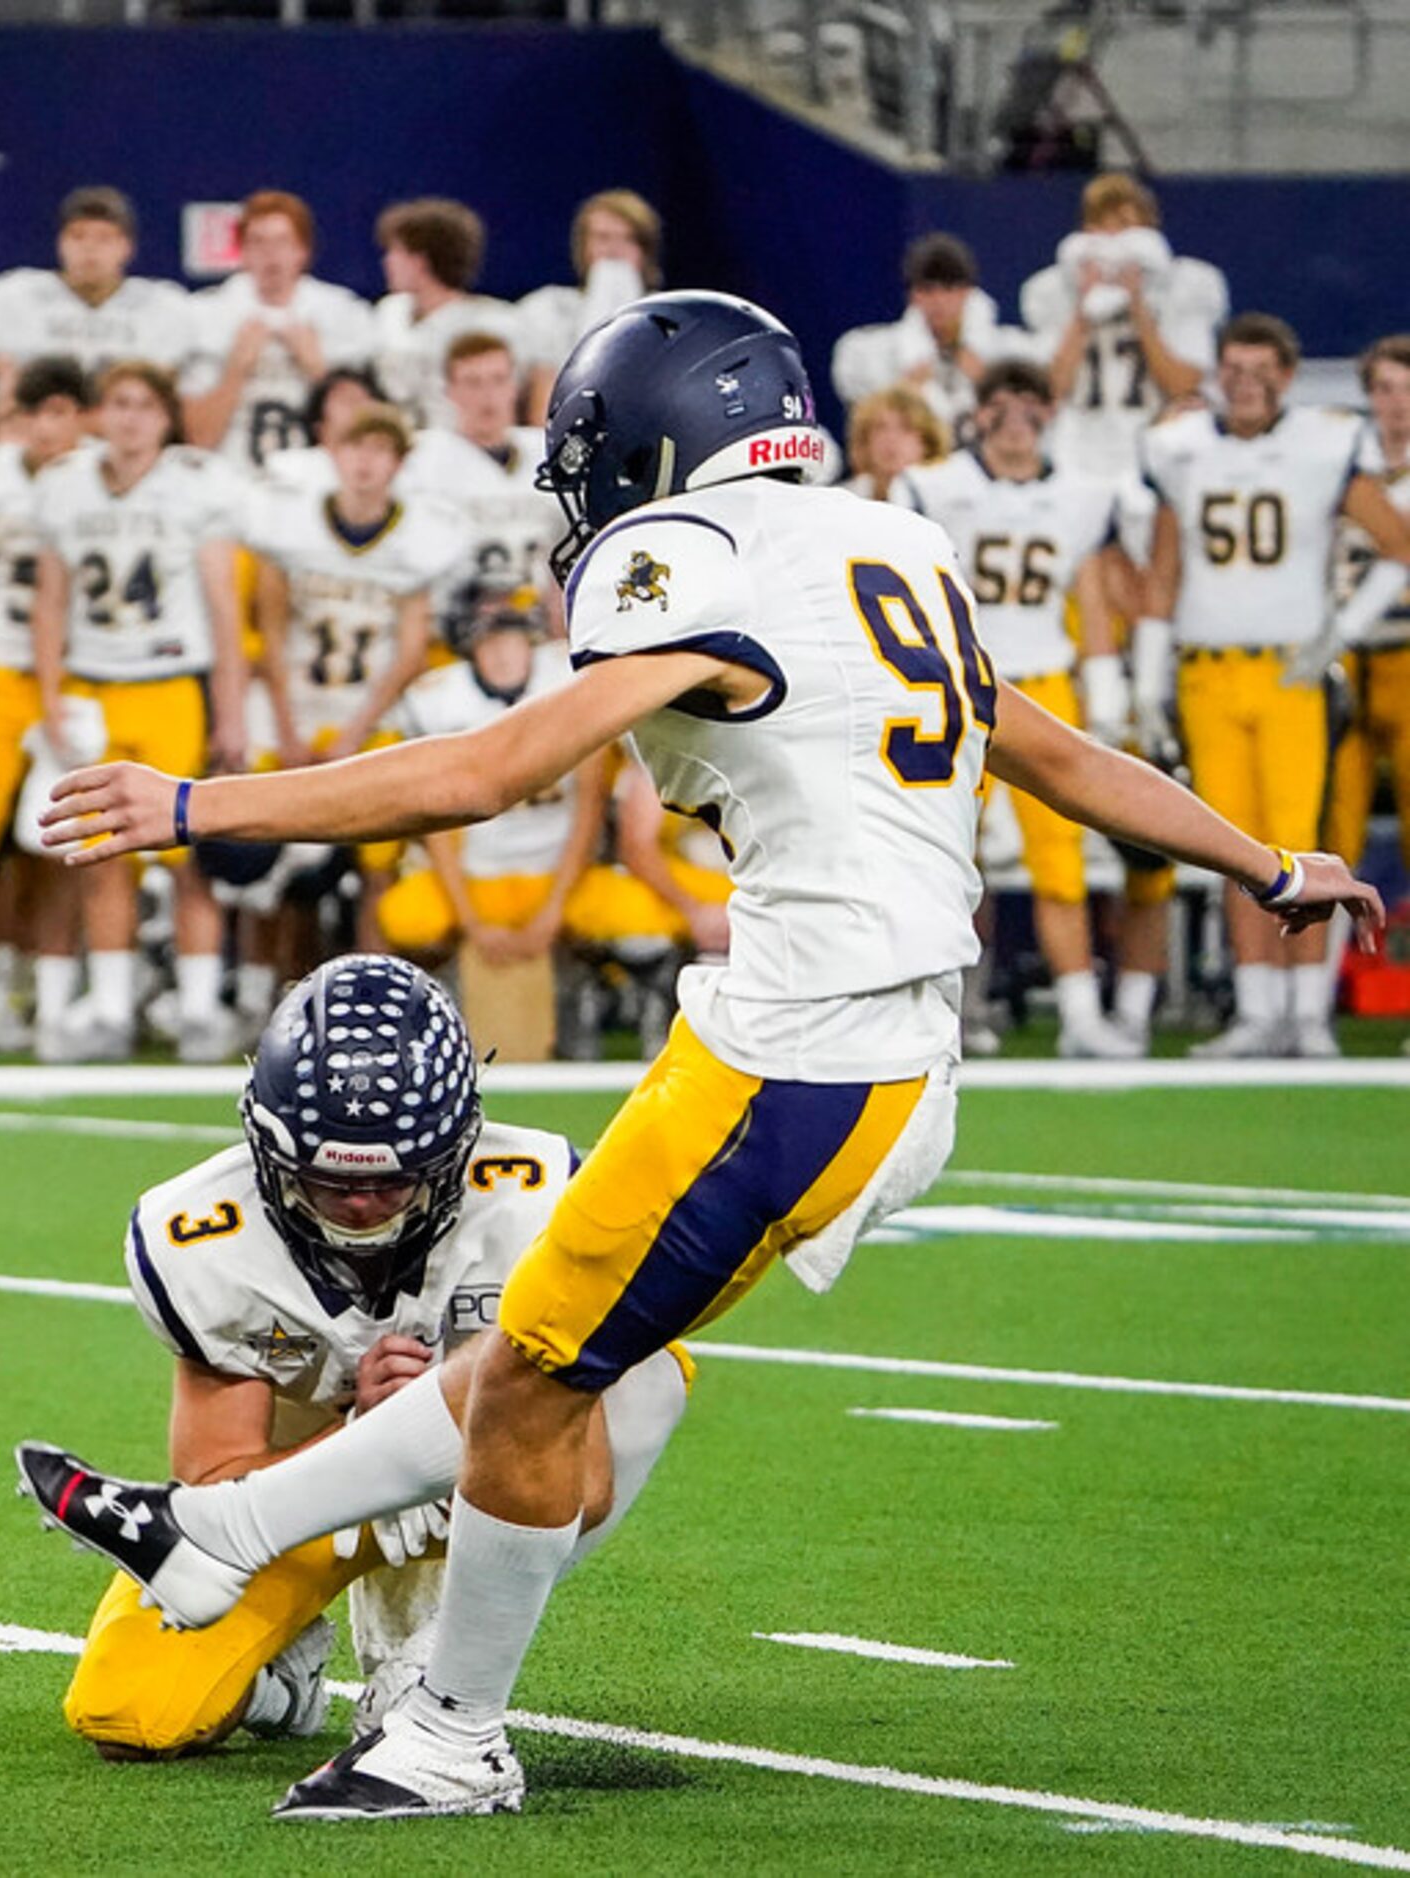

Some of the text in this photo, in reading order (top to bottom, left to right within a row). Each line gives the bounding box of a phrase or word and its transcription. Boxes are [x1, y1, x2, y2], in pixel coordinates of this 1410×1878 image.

[1200, 490, 1286, 567] 50
[77, 550, 160, 623] 24
[974, 532, 1057, 607] 56
[846, 556, 998, 790] 94
[470, 1155, 546, 1192] 3
[166, 1199, 244, 1248] 3
